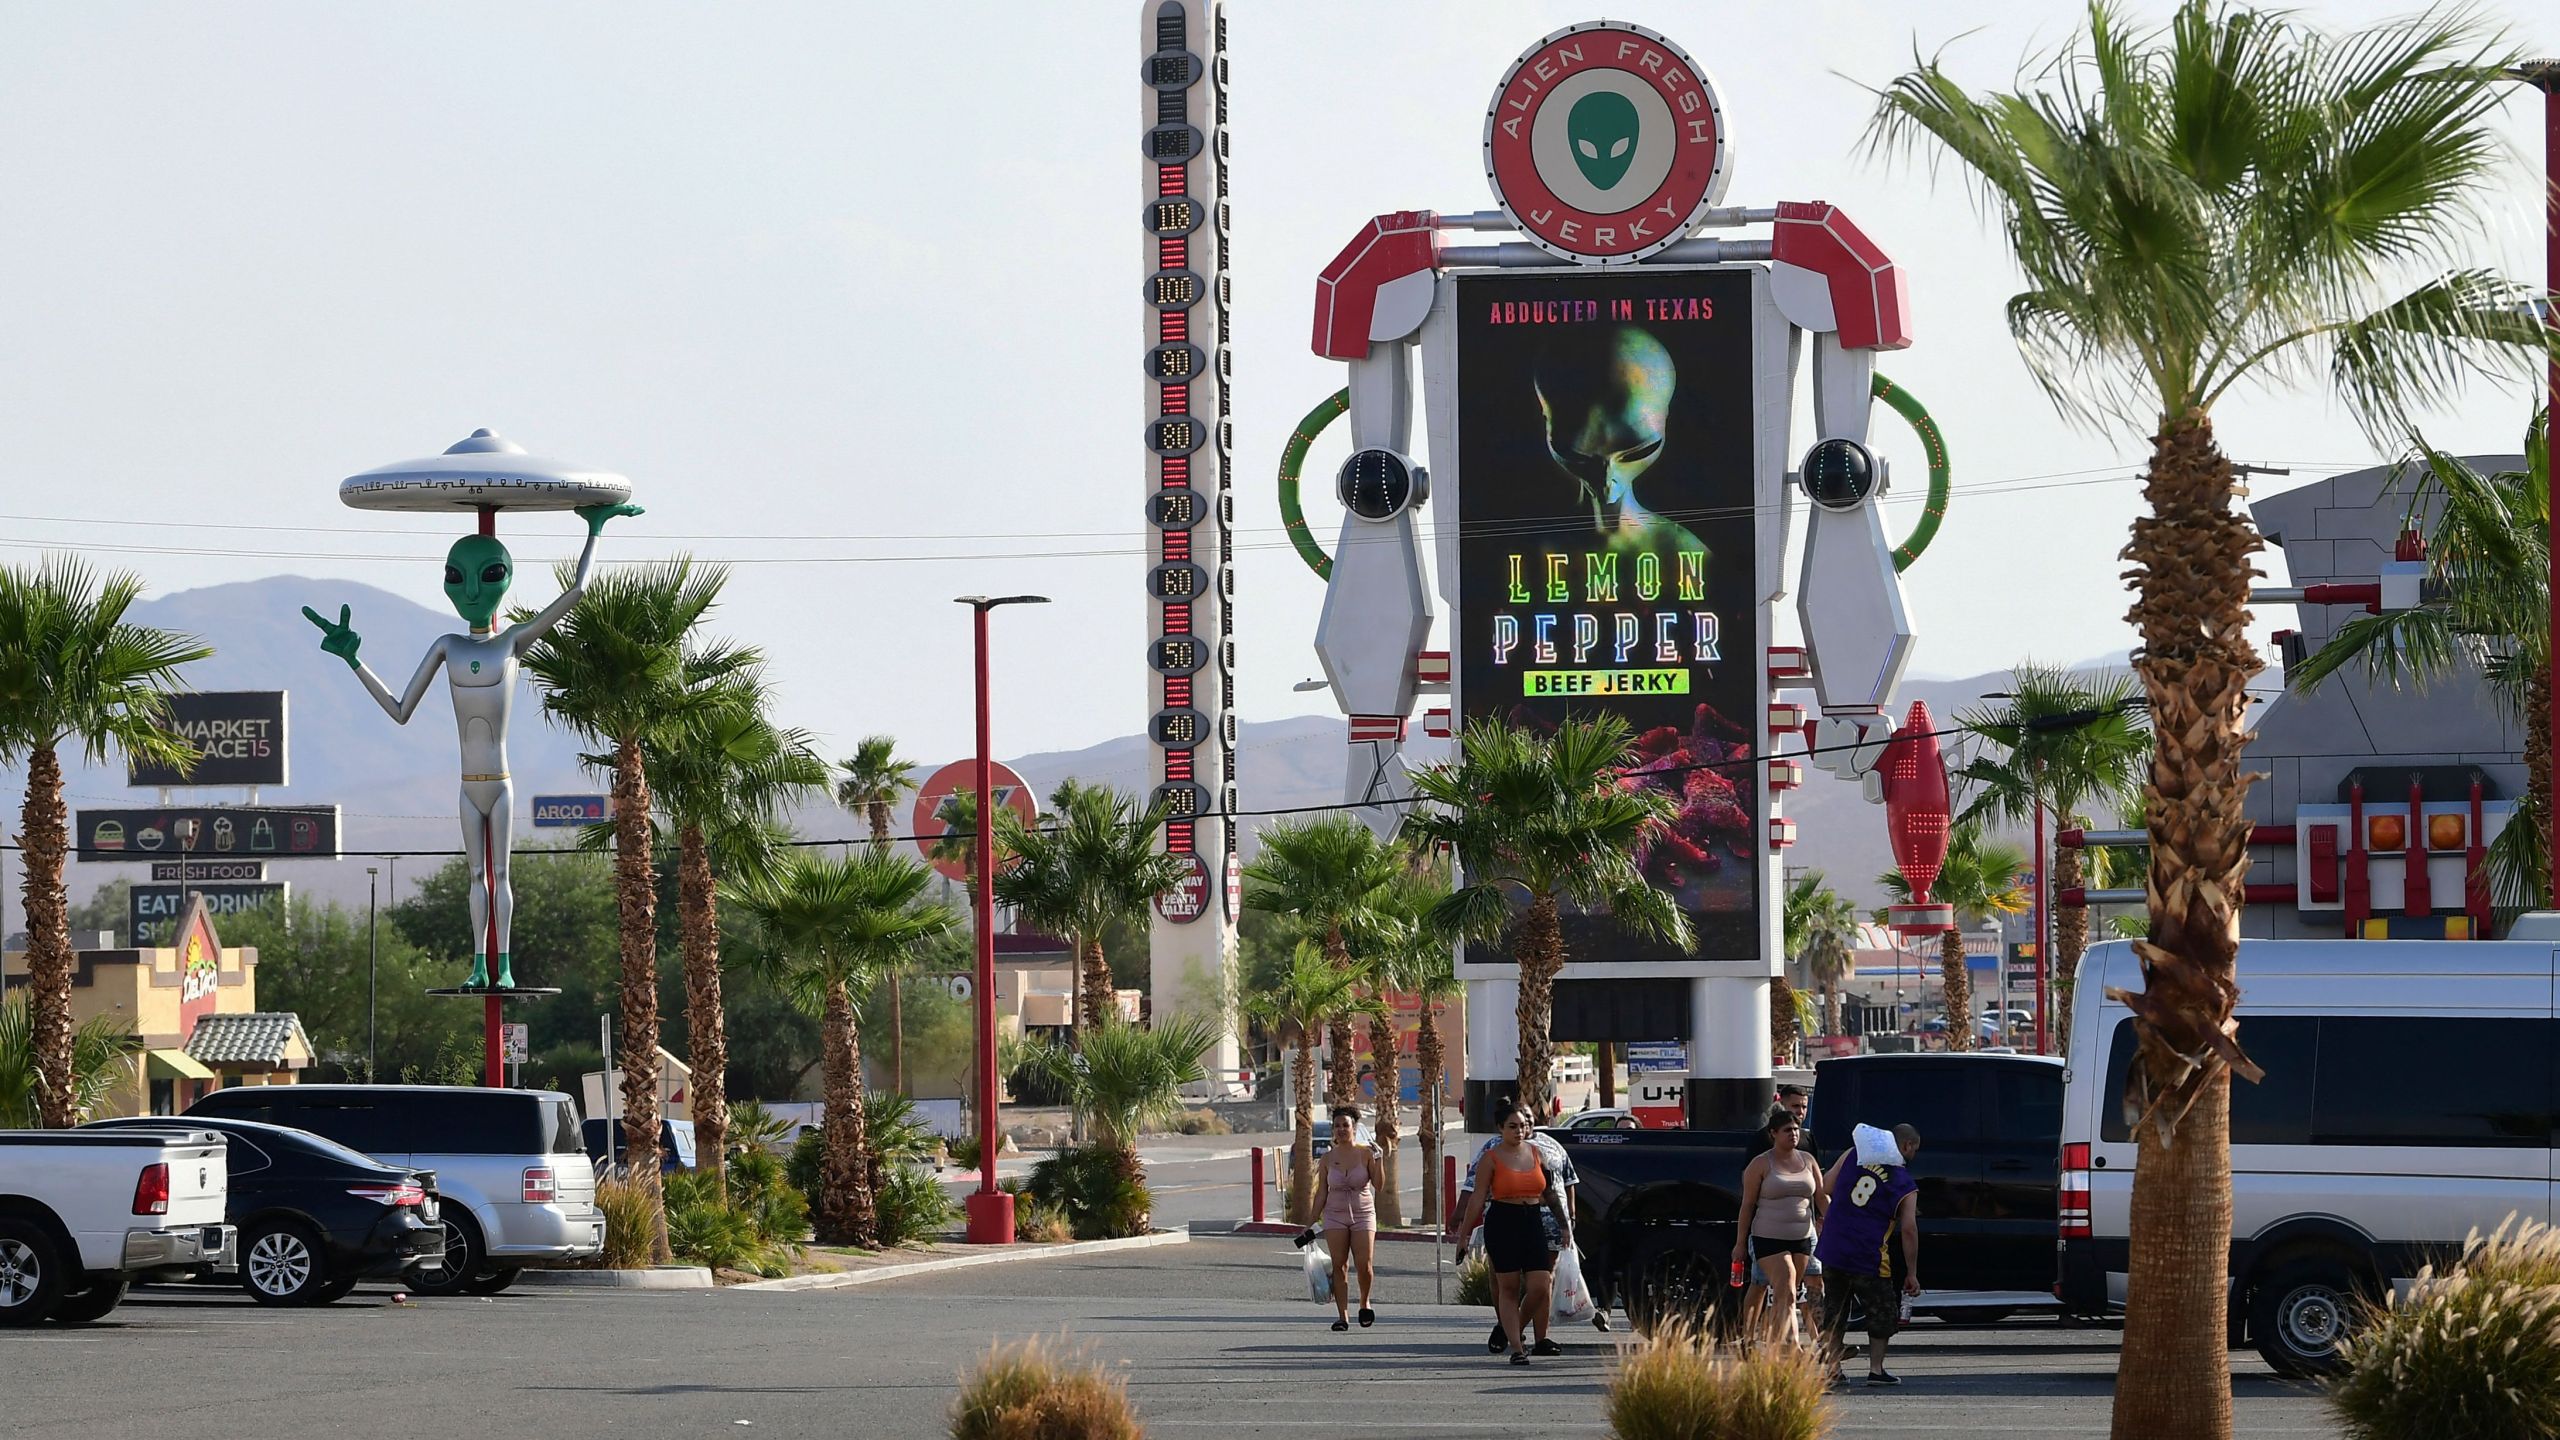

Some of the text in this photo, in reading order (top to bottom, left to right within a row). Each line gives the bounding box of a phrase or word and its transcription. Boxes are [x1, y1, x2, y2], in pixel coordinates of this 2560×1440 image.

[1503, 41, 1709, 144] ALIEN FRESH
[1530, 197, 1677, 247] JERKY
[1157, 277, 1192, 303] 100
[1490, 297, 1714, 324] ABDUCTED IN TEXAS
[1162, 349, 1189, 376] 90
[1163, 423, 1190, 449] 80
[1164, 495, 1190, 522] 70
[1165, 569, 1192, 595] 60
[1508, 551, 1706, 603] LEMON
[1493, 611, 1722, 665] PEPPER
[1166, 642, 1192, 669] 50
[1535, 673, 1678, 693] BEEF JERKY
[173, 718, 271, 739] MARKET
[1167, 714, 1194, 742] 40
[537, 804, 584, 820] ARCO
[1168, 788, 1194, 814] 30
[157, 865, 256, 879] FRESH FOOD
[138, 895, 180, 914] EAT
[1850, 1175, 1877, 1207] 8
